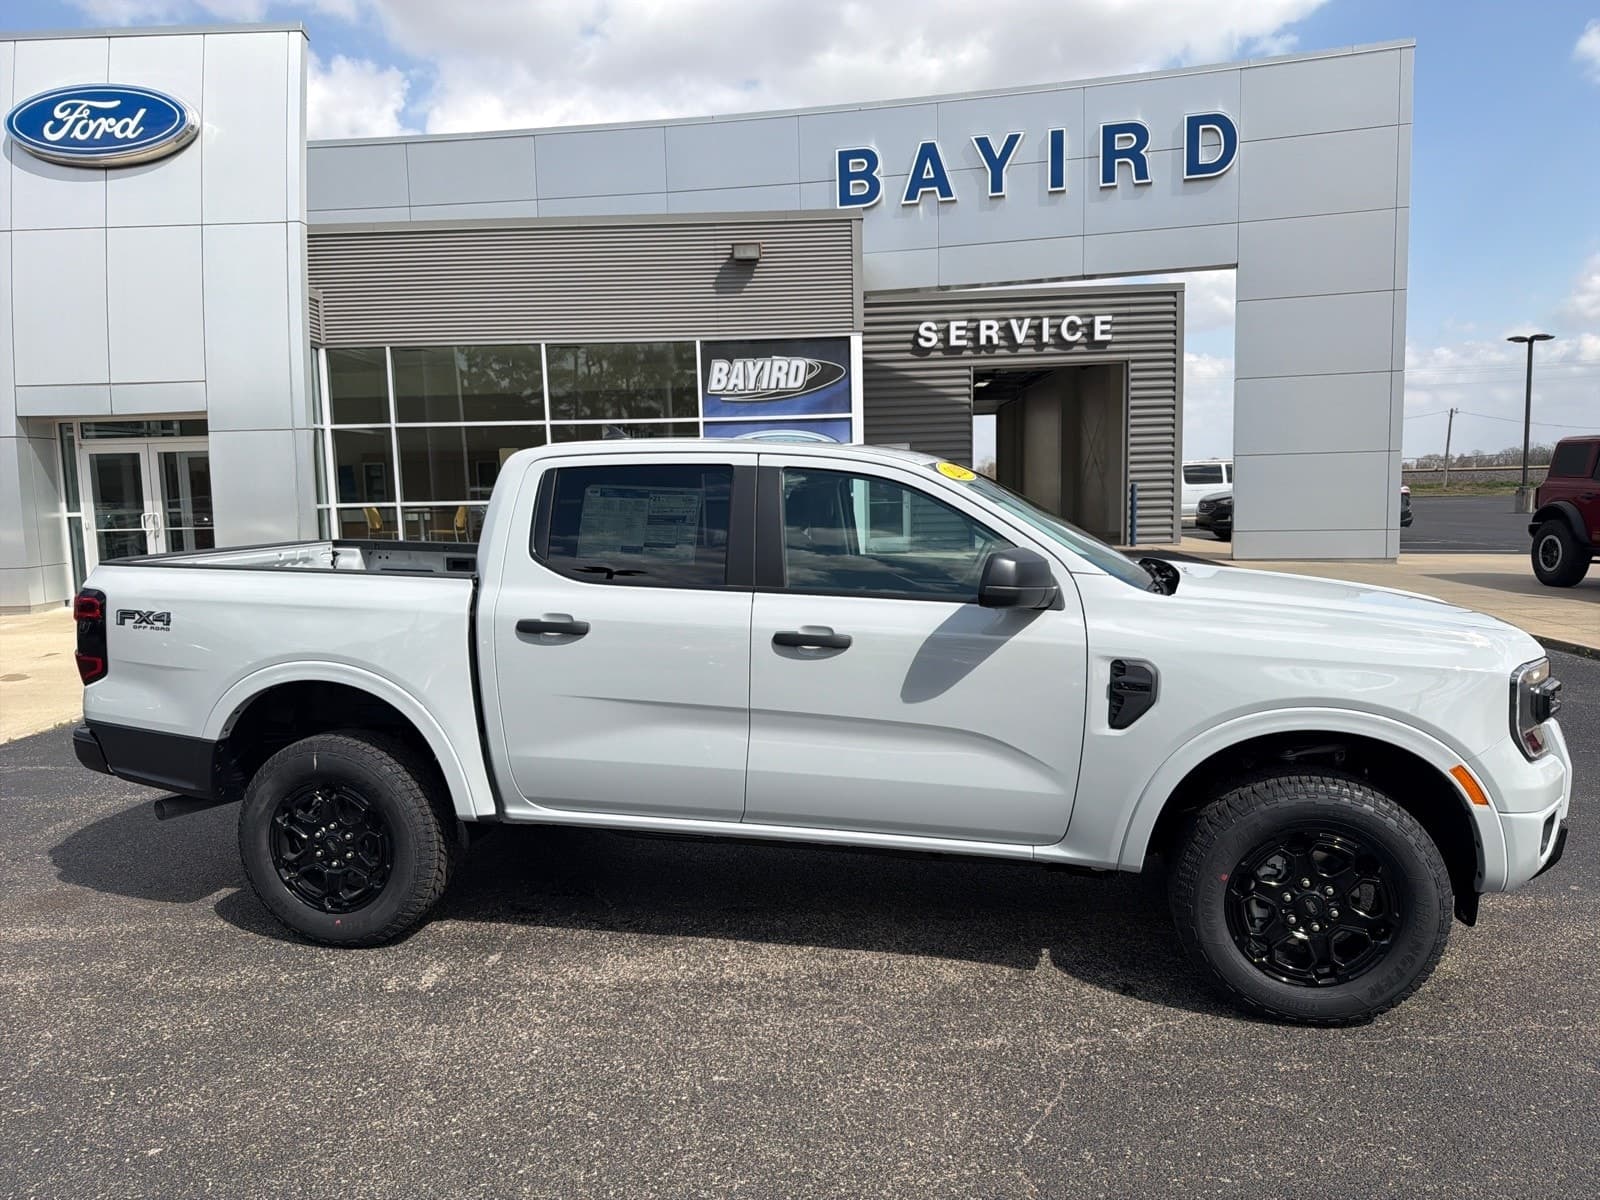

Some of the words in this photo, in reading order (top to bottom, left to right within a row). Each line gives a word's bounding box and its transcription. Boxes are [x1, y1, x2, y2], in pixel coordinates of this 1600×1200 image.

[43, 99, 147, 141] Ford
[836, 111, 1239, 209] BAYIRD
[917, 315, 1113, 348] SERVICE
[708, 358, 808, 393] BAYIRD
[115, 609, 171, 626] FX4
